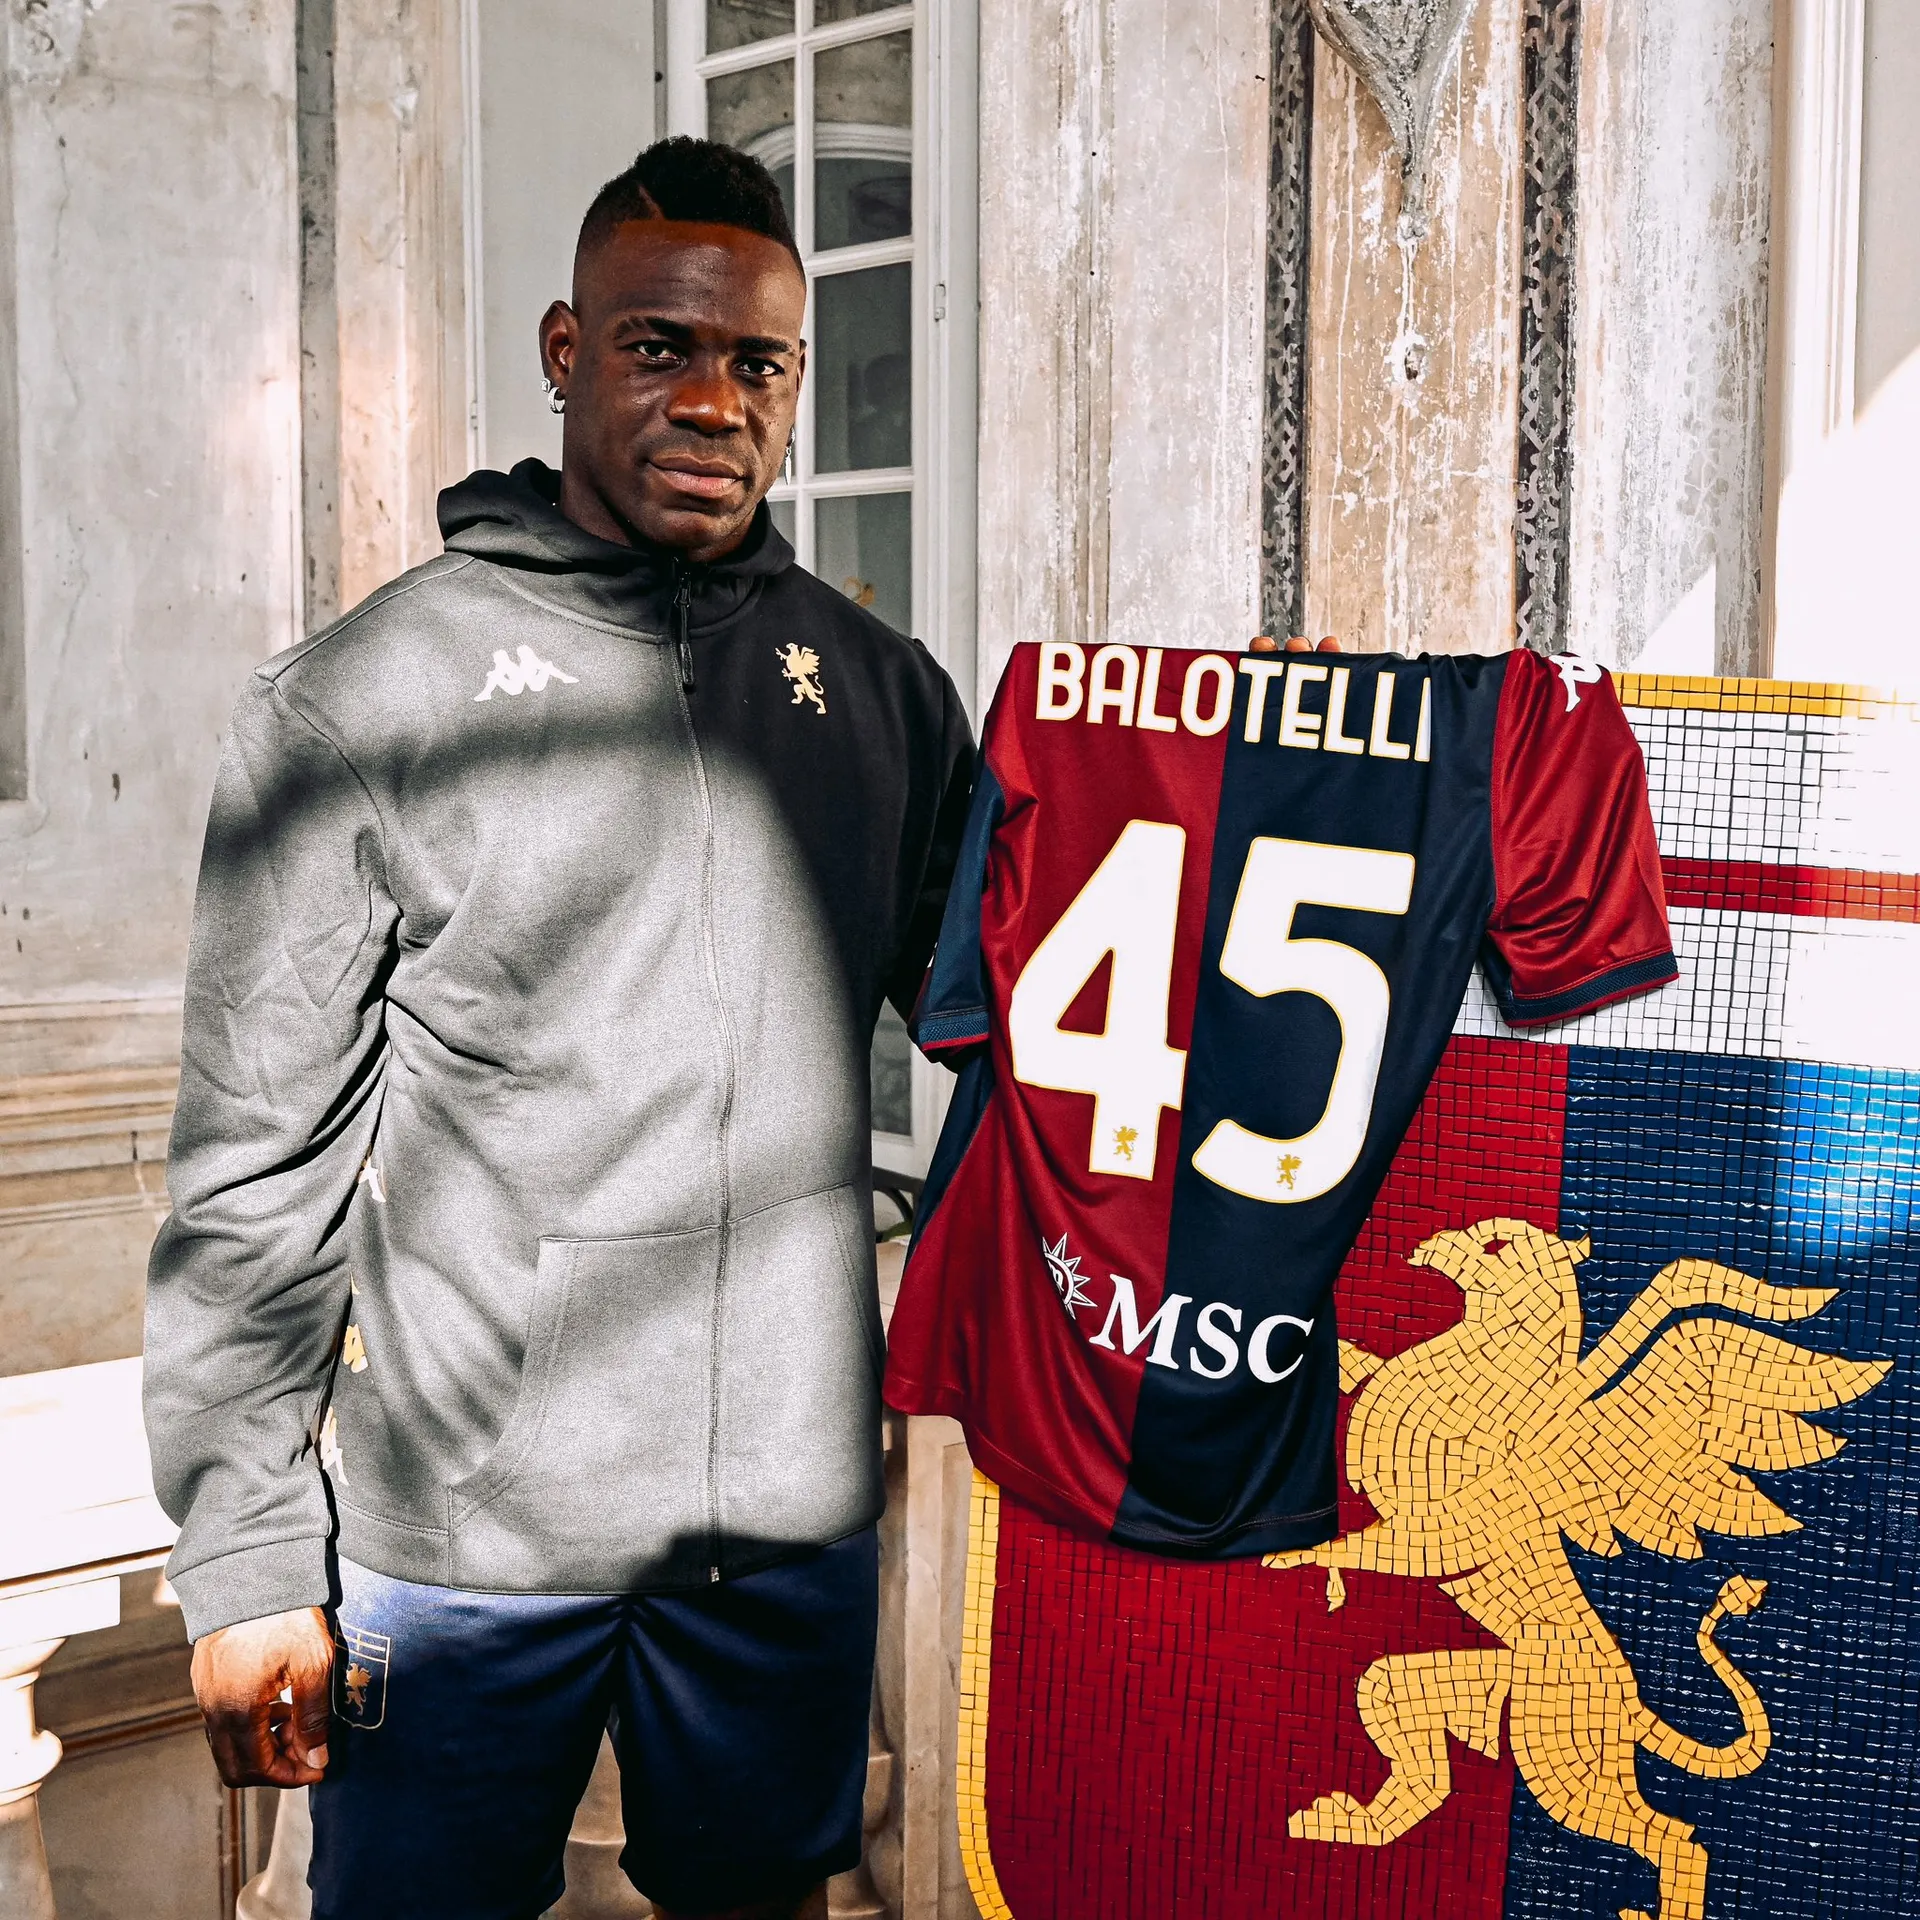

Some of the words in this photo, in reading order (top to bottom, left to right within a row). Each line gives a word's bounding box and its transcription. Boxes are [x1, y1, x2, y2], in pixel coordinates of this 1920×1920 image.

[1035, 641, 1431, 762] BALOTELLI
[1008, 818, 1416, 1204] 45
[1088, 1273, 1314, 1384] MSC
